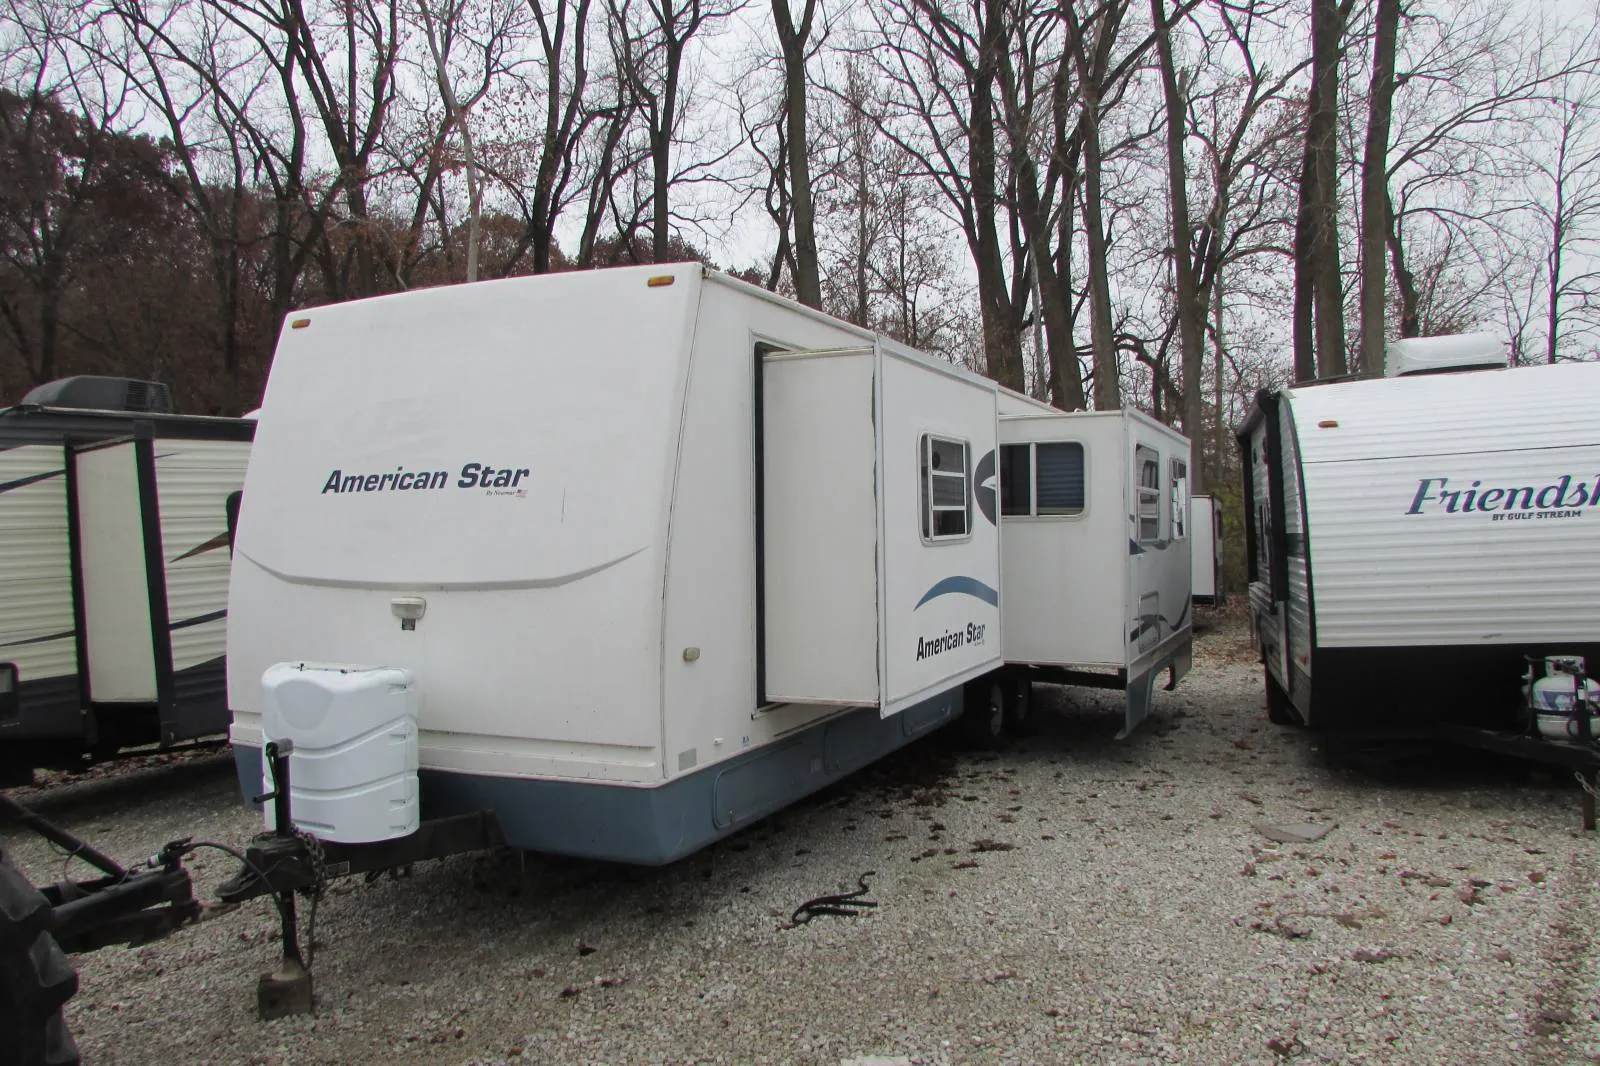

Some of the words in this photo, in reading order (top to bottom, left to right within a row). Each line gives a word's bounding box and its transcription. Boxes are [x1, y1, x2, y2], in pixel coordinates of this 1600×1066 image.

[321, 466, 448, 494] American
[457, 462, 530, 489] Star
[1492, 513, 1505, 521] BY
[1507, 512, 1534, 520] GULF
[1536, 510, 1582, 519] STREAM
[916, 629, 964, 662] American
[966, 622, 986, 643] Star
